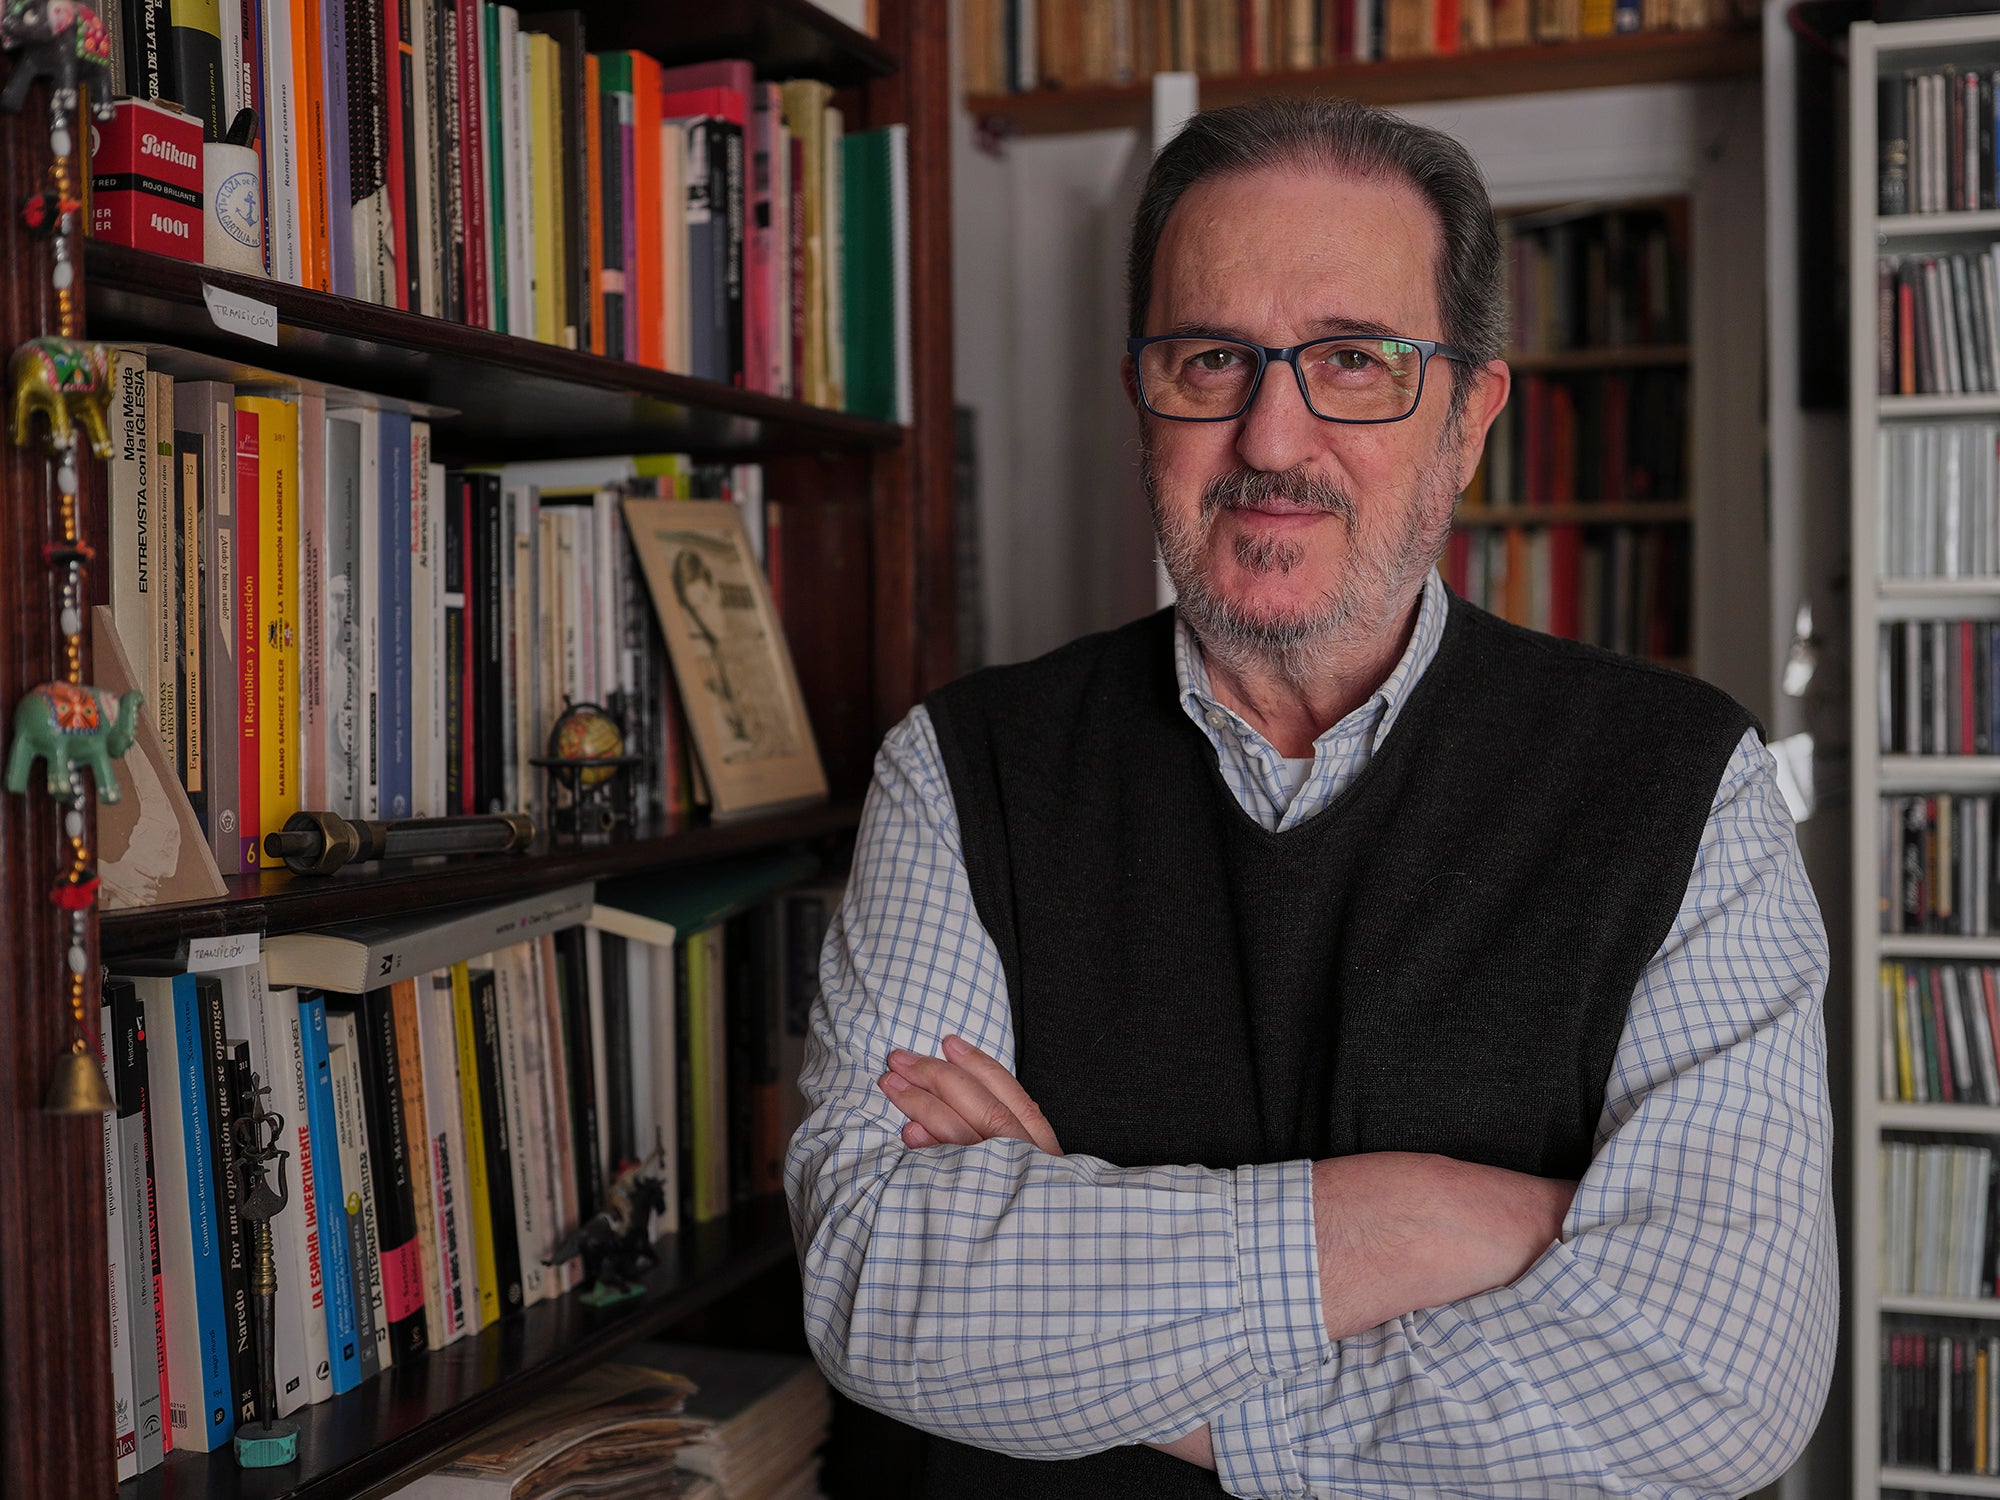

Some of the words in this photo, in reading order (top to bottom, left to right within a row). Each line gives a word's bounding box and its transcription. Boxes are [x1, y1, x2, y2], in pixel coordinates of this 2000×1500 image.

[148, 51, 157, 70] DE
[149, 72, 159, 101] GRA
[141, 133, 197, 170] Pelikan
[283, 133, 288, 144] el
[142, 180, 162, 192] ROJO
[163, 186, 196, 202] BRILLANTE
[226, 178, 241, 198] LOZA
[218, 202, 227, 214] LA
[150, 213, 189, 239] 4001
[222, 214, 250, 243] CARTUJA
[122, 367, 134, 417] Mérida
[135, 369, 145, 436] IGLESIA
[123, 419, 136, 461] María
[137, 439, 146, 452] la
[138, 454, 147, 486] con
[219, 448, 227, 463] Soto
[419, 436, 427, 480] Estado
[220, 464, 228, 494] Carmona
[137, 490, 148, 593] ENTREVISTA
[219, 534, 230, 564] ¿Atado
[275, 536, 283, 596] TRANSICIÓN
[219, 574, 230, 591] bien
[343, 561, 352, 627] Transición
[221, 592, 230, 620] atado?
[244, 575, 254, 640] transición
[277, 600, 284, 614] LA
[343, 631, 352, 643] la
[162, 644, 170, 663] Reyna
[344, 647, 352, 663] en
[189, 671, 197, 725] uniforme
[244, 659, 255, 723] República
[343, 665, 352, 712] Franco
[159, 682, 168, 733] FORMAS
[166, 682, 175, 736] HISTORIA
[277, 695, 285, 744] SÁNCHEZ
[308, 713, 313, 725] LA
[245, 728, 254, 737] II
[343, 715, 352, 731] de
[167, 738, 175, 753] LA
[189, 728, 198, 770] España
[343, 735, 352, 781] sombra
[344, 784, 352, 801] La
[246, 842, 257, 864] 6
[183, 1001, 192, 1033] Fortes
[210, 999, 224, 1061] oponga
[313, 1008, 322, 1031] CIS
[125, 1028, 134, 1068] Historia
[186, 1035, 195, 1061] Xosé
[291, 1018, 301, 1058] PUNSET
[189, 1066, 197, 1103] victoria
[216, 1065, 225, 1082] se
[295, 1061, 306, 1111] EDUARDO
[190, 1104, 198, 1114] la
[218, 1087, 232, 1117] que
[104, 1114, 111, 1124] la
[104, 1125, 114, 1174] Transición
[193, 1117, 204, 1156] otorgan
[132, 1142, 141, 1189] (1974-1978)
[220, 1122, 237, 1199] oposición
[196, 1157, 206, 1199] derrotas
[299, 1126, 316, 1227] IMPERTINENTE
[359, 1151, 372, 1201] MILITAR
[107, 1176, 116, 1216] española
[228, 1205, 239, 1236] una
[201, 1216, 210, 1257] Cuando
[355, 1241, 363, 1258] que
[363, 1204, 381, 1287] ALTERNATIVA
[230, 1242, 241, 1269] Por
[306, 1232, 321, 1287] ESPAÑA
[356, 1260, 363, 1270] lo
[108, 1263, 117, 1317] Encarnación
[358, 1271, 364, 1280] es
[359, 1282, 365, 1294] no
[312, 1289, 324, 1309] LA
[360, 1296, 368, 1324] futuro
[373, 1291, 382, 1308] LA
[234, 1289, 249, 1354] Naredo
[363, 1325, 370, 1335] El
